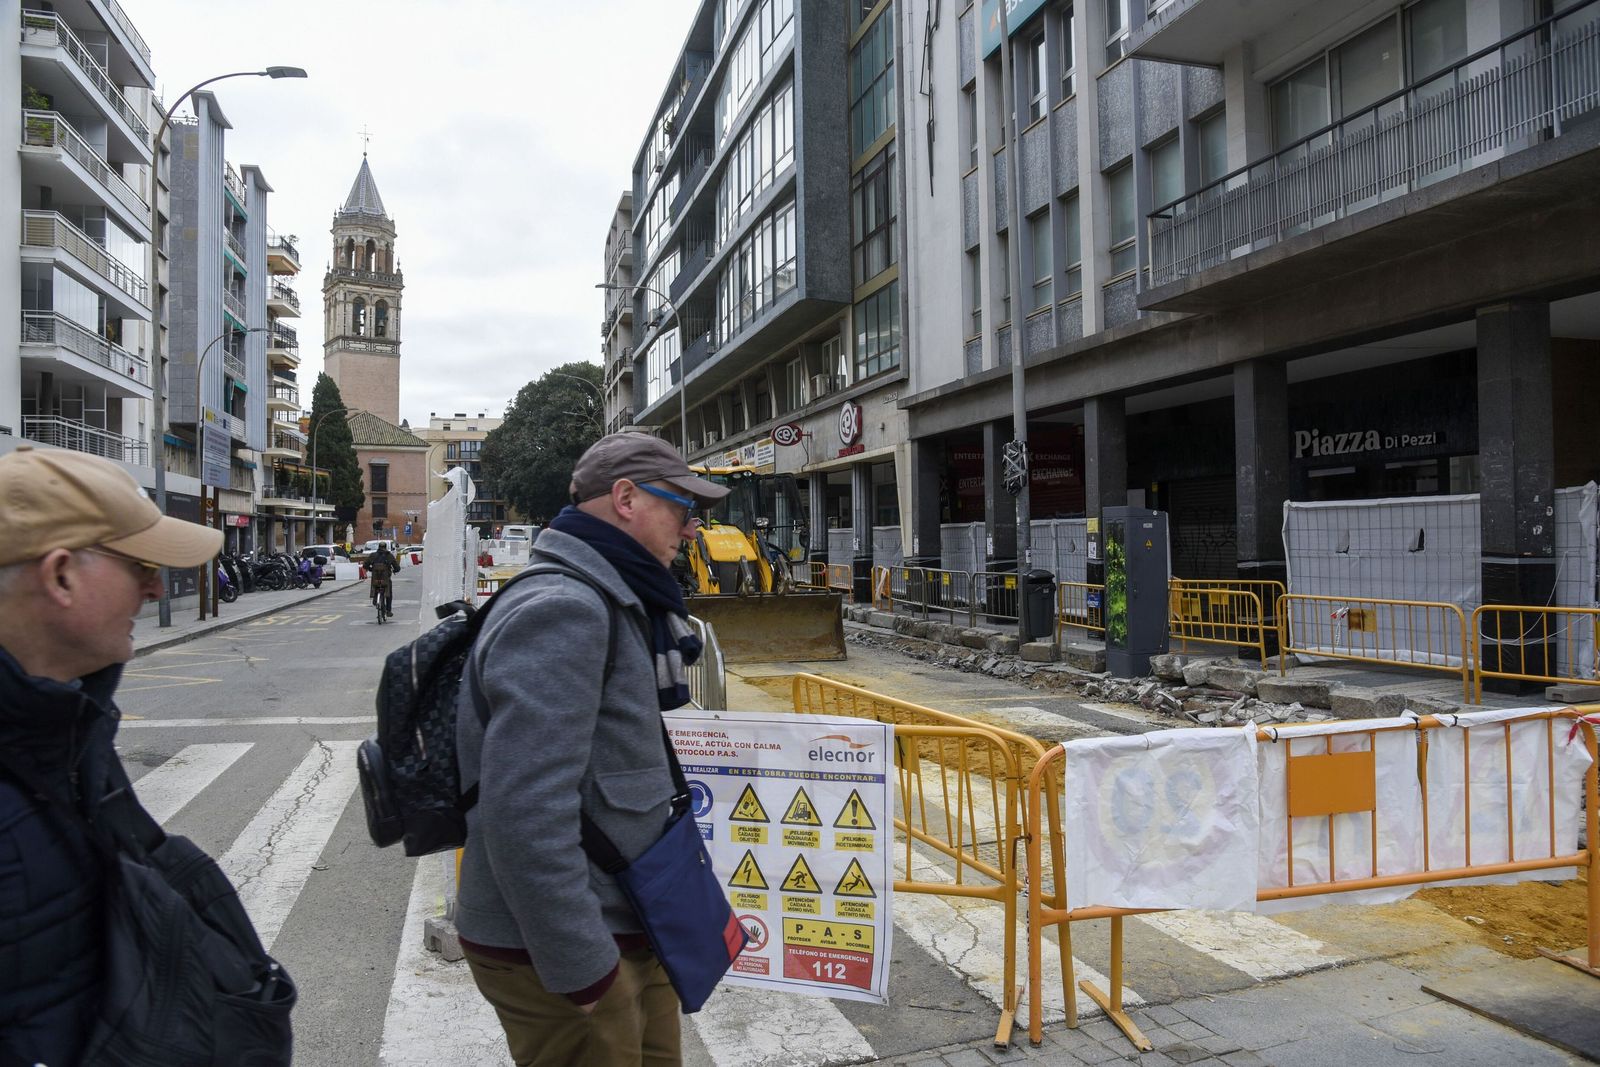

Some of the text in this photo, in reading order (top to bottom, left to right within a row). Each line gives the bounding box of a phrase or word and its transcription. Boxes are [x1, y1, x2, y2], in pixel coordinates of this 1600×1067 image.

[1294, 428, 1381, 458] Piazza
[675, 730, 729, 739] EMERGENCIA,
[674, 739, 702, 747] GRAVE,
[808, 746, 875, 762] elecnor
[823, 773, 876, 782] ENCONTRAR:
[796, 924, 803, 934] P
[824, 927, 833, 937] A
[854, 930, 862, 940] S
[829, 953, 869, 963] EMERGENCIAS
[812, 961, 846, 980] 112
